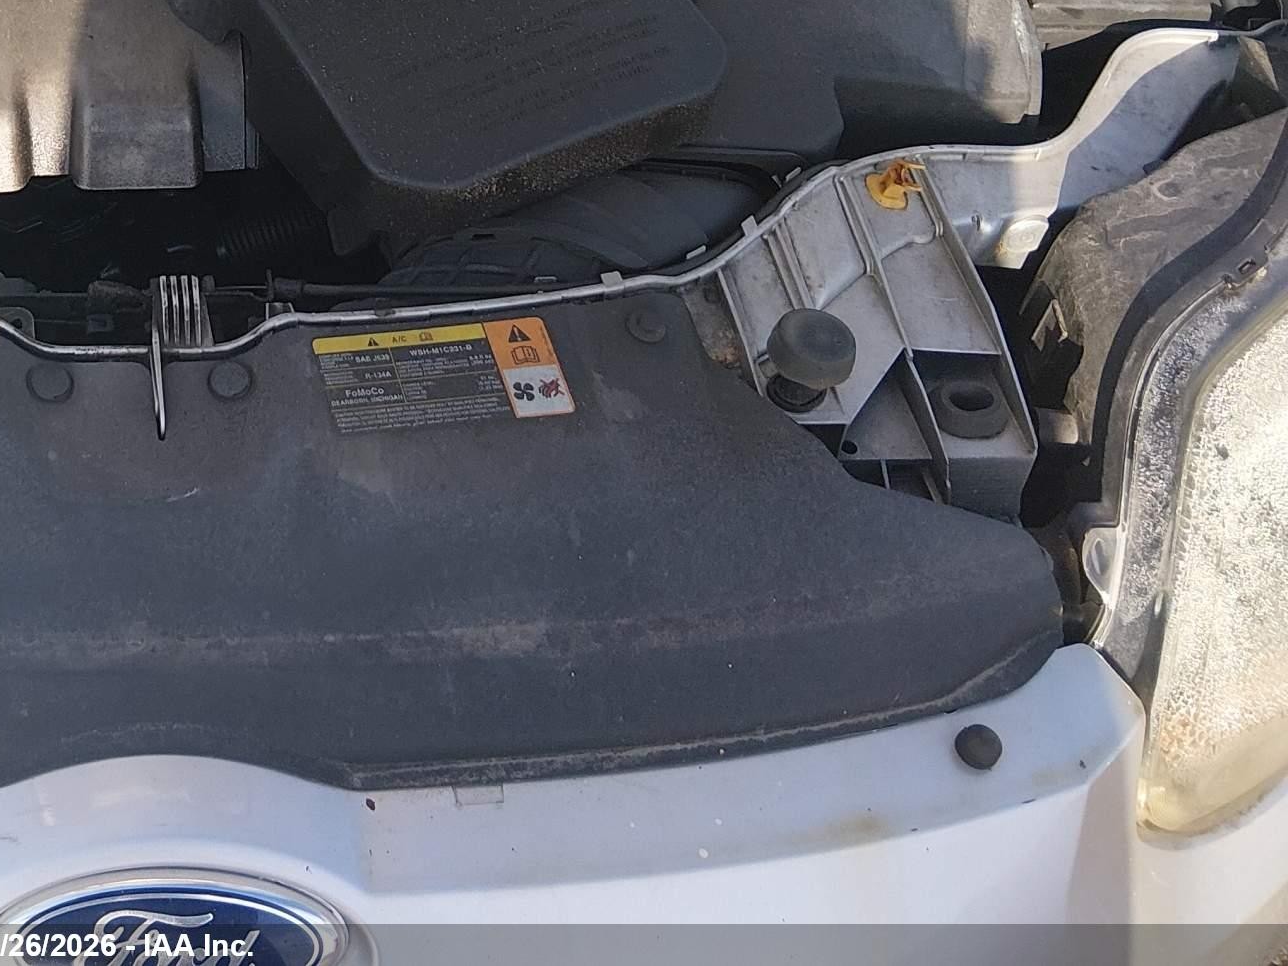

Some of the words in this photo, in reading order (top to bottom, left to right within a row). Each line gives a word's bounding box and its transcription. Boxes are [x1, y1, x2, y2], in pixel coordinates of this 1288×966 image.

[392, 335, 407, 343] A/C
[364, 371, 392, 380] R-134A
[345, 387, 385, 398] FoMoCo
[371, 394, 404, 402] MICHIGAN
